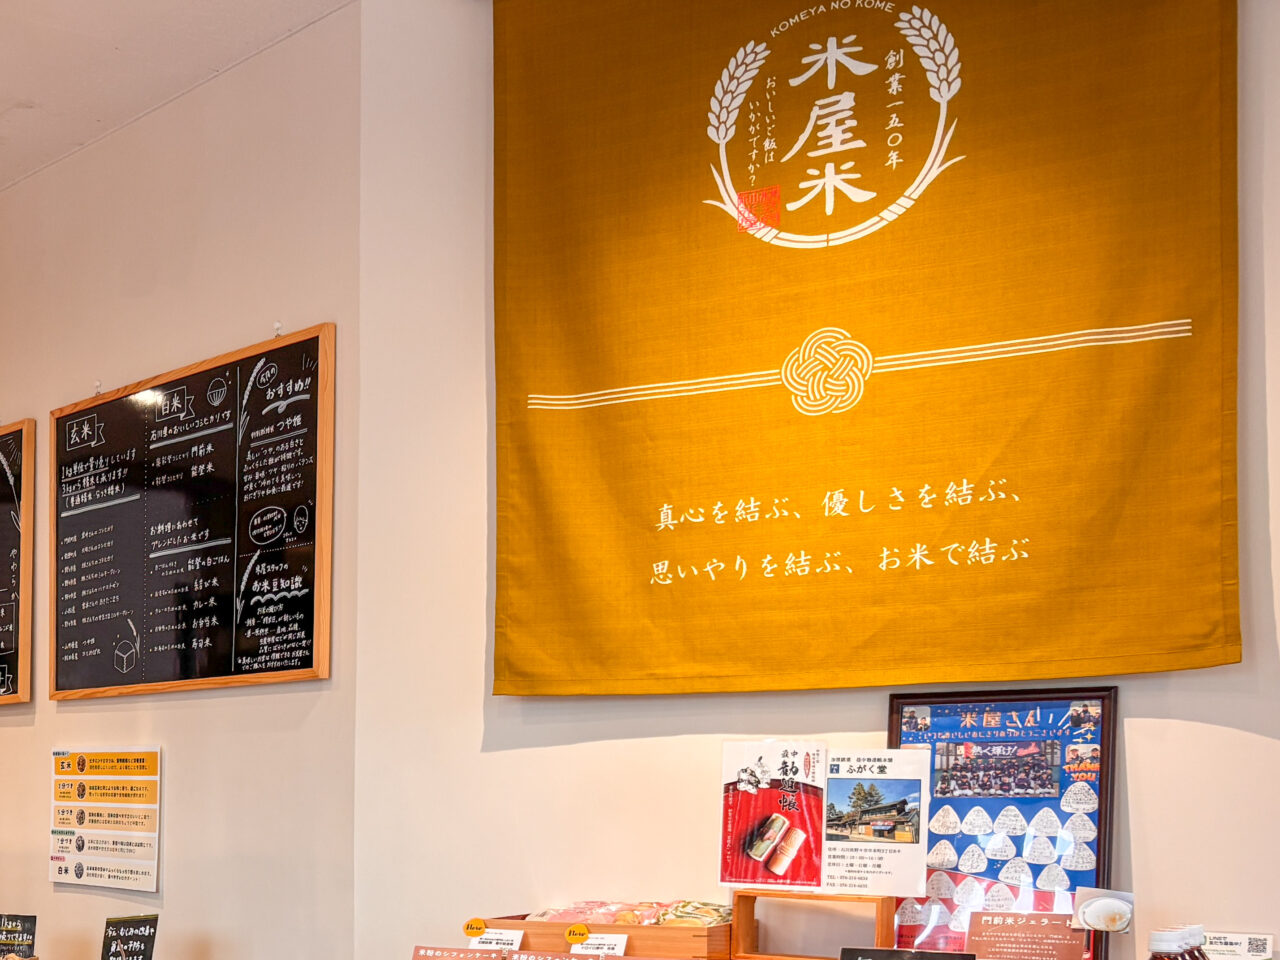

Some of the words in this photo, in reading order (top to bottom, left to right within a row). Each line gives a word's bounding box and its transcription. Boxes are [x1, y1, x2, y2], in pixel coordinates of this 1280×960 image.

[770, 5, 826, 37] KOMEYA
[830, 0, 851, 10] NO
[855, 0, 896, 13] KOME
[762, 76, 778, 164] おいしいご飯は
[780, 35, 879, 216] 米屋米
[747, 101, 761, 187] いかがですか?
[266, 377, 312, 400] おすすめ!!
[161, 393, 182, 416] 白米
[71, 420, 92, 445] 玄米
[277, 414, 302, 431] つや姫
[191, 443, 215, 458] 門前米
[190, 461, 215, 478] 能登米
[655, 478, 1021, 532] 真心を結ぶ、優しさを結ぶ、
[150, 517, 199, 536] お料理にあわせて
[151, 528, 210, 551] ブレンドしたお米です
[187, 554, 230, 572] 能登の白ごはん
[649, 537, 1030, 585] 思いやりを結ぶ、お米で結ぶ
[10, 548, 20, 601] やわらか
[252, 576, 303, 592] お米豆知識
[193, 596, 217, 610] カレー米
[846, 764, 888, 775] ふがく堂
[981, 916, 1072, 927] 門前米ジェラート
[418, 949, 498, 959] 米粉のシフォンケーキ
